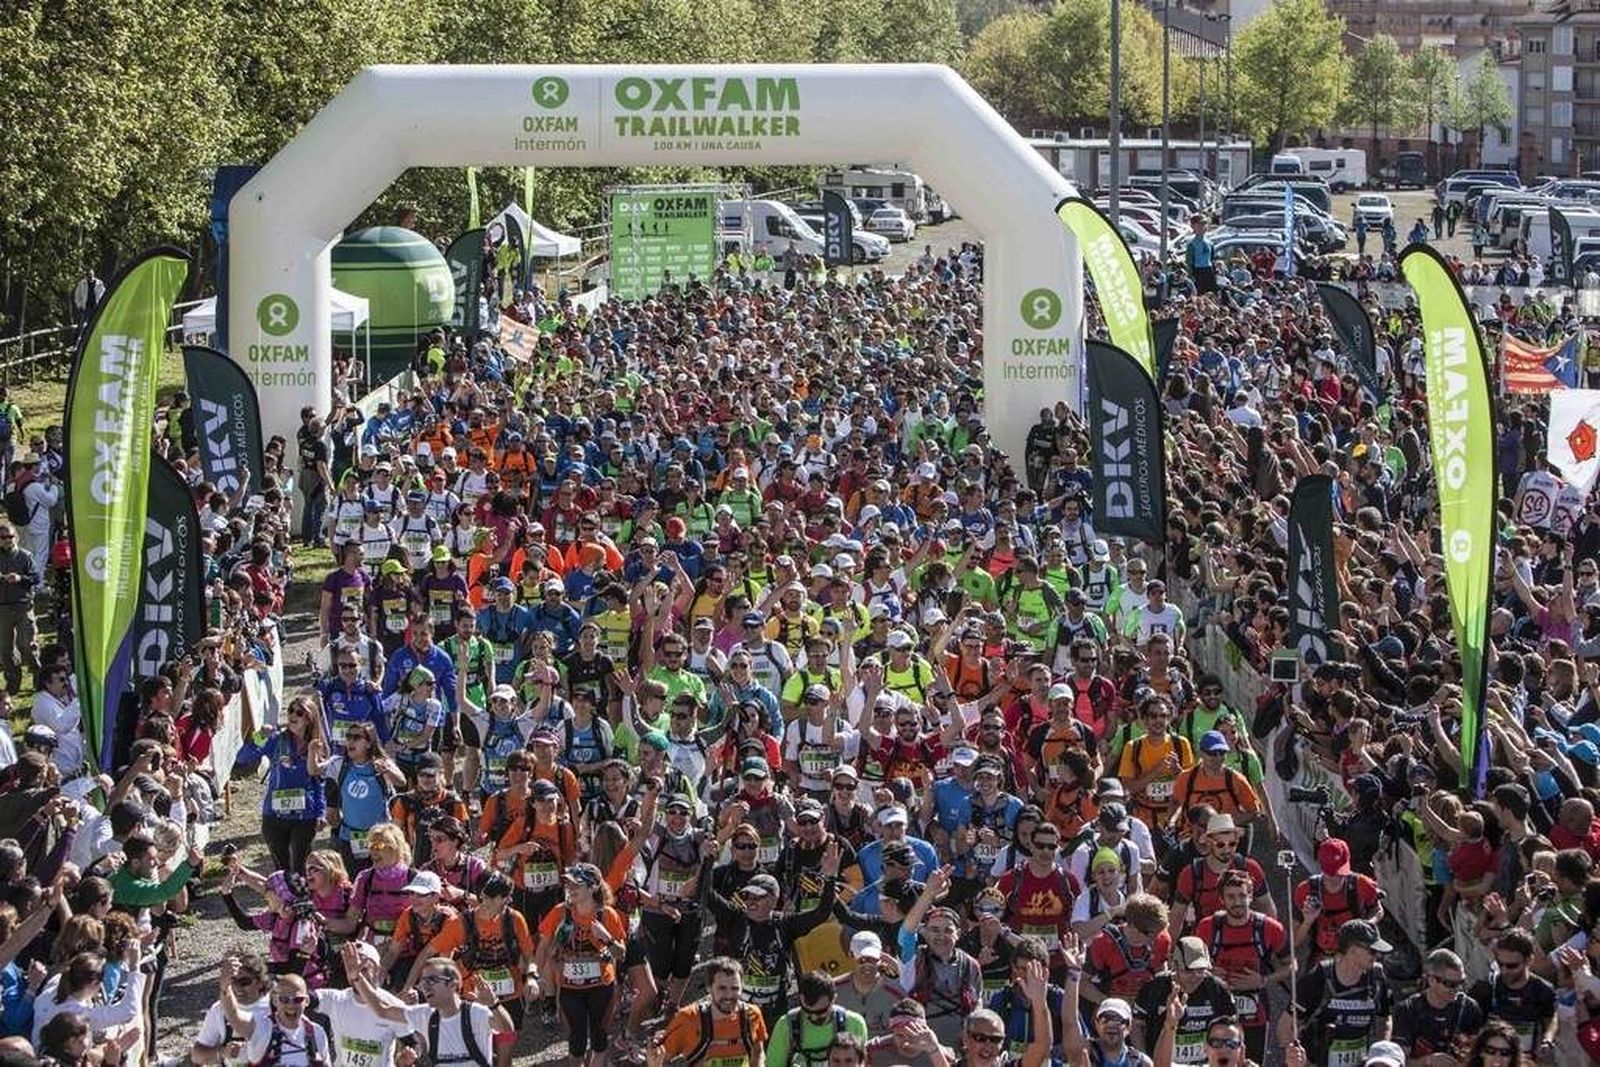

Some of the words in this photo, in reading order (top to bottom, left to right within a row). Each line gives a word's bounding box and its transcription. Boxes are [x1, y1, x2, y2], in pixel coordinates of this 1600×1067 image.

[614, 76, 800, 111] OXFAM
[523, 116, 579, 133] OXFAM
[614, 115, 800, 137] TRAILWALKER
[514, 135, 586, 152] Intermón
[653, 140, 674, 151] 100
[676, 140, 692, 151] KM
[701, 140, 724, 151] UNA
[726, 140, 762, 151] CAUSA
[653, 197, 708, 211] OXFAM
[247, 344, 310, 363] OXFAM
[1011, 338, 1070, 356] OXFAM
[1003, 361, 1077, 380] Intermón
[90, 334, 128, 506] OXFAM
[1134, 397, 1148, 458] MÉDICOS
[1101, 398, 1135, 518] DKV
[1138, 459, 1153, 520] SEGUROS
[137, 516, 175, 678] DKV
[175, 601, 187, 664] GUROS
